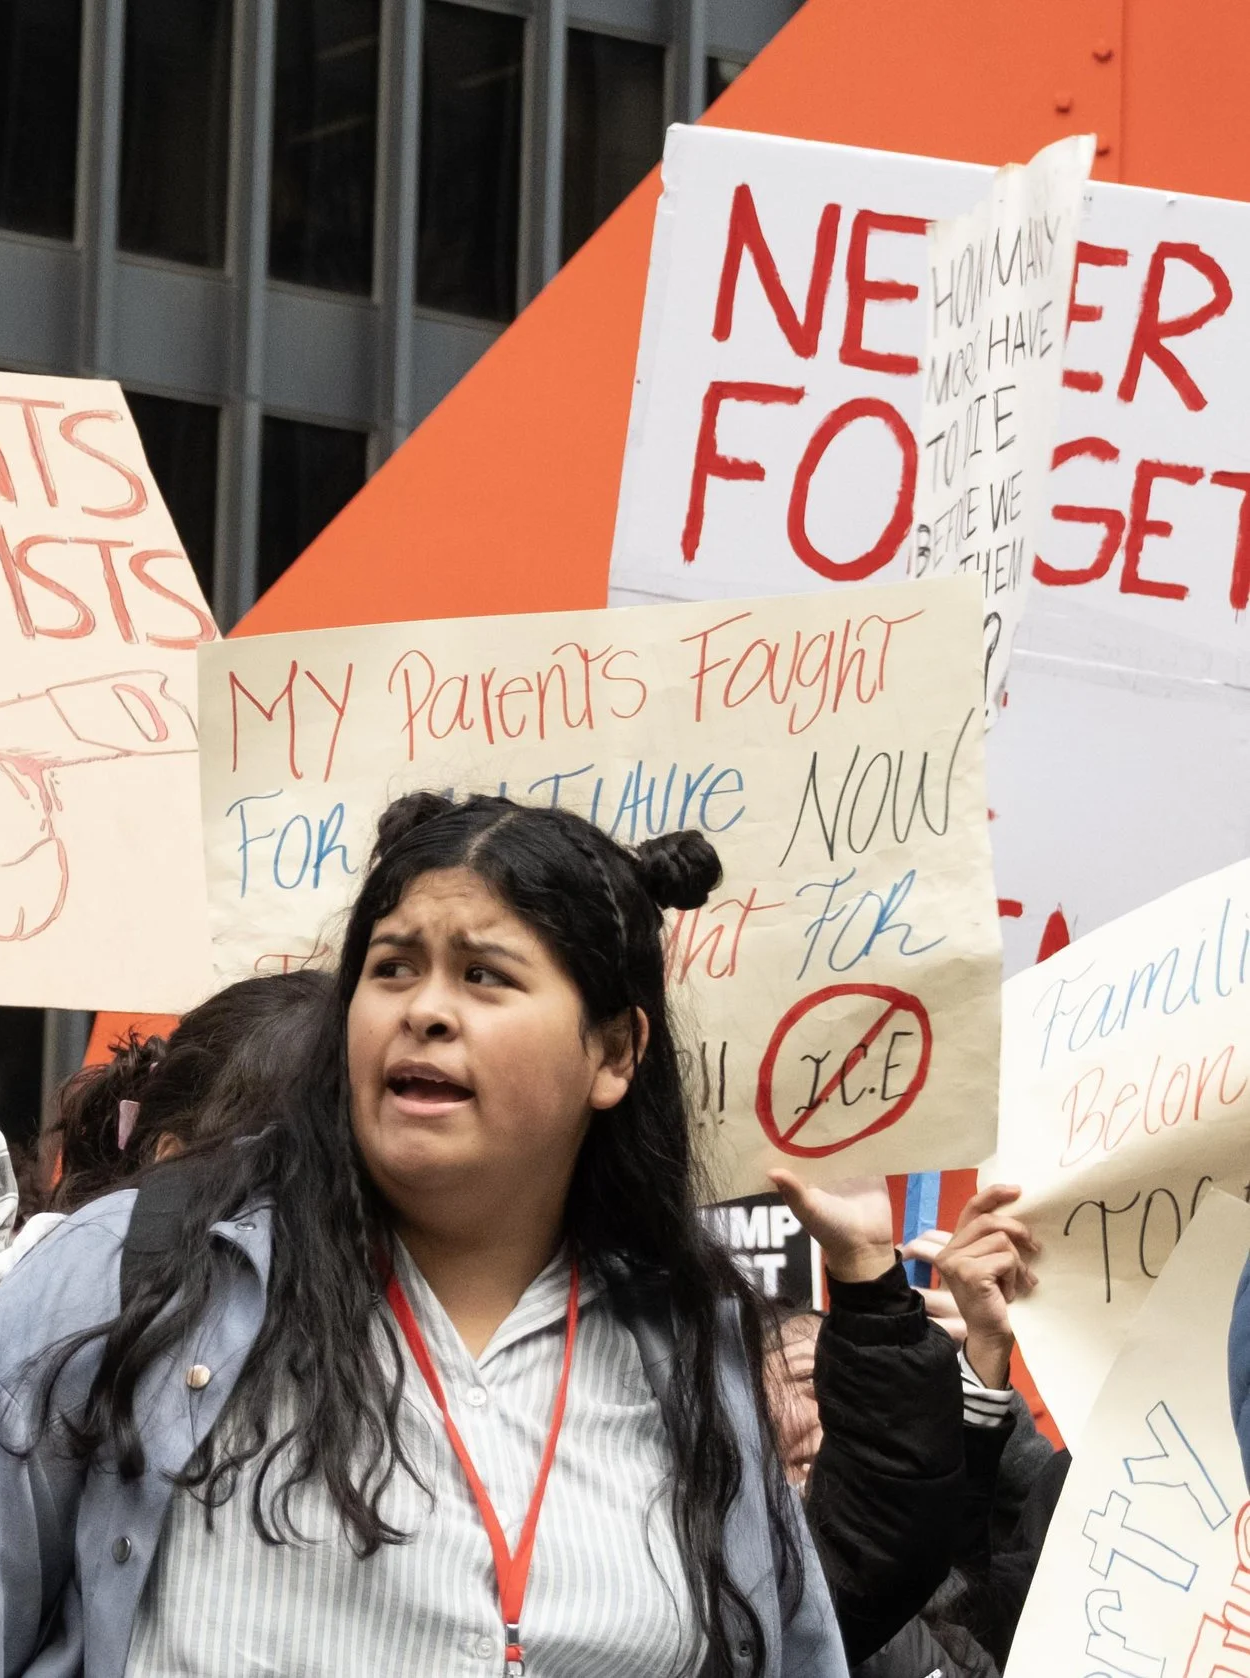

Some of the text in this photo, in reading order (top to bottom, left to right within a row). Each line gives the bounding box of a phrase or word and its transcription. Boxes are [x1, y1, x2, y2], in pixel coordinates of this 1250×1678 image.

[712, 183, 1233, 411] NEER
[931, 210, 1062, 339] HOW MANY
[988, 300, 1053, 372] HAVE
[681, 380, 1250, 609] FOGET
[926, 420, 959, 493] TO
[990, 470, 1023, 533] WE
[229, 660, 353, 783] MY
[226, 789, 359, 899] FOR
[778, 707, 976, 868] NOW
[795, 867, 948, 981] FOR
[1064, 1175, 1212, 1304] TO
